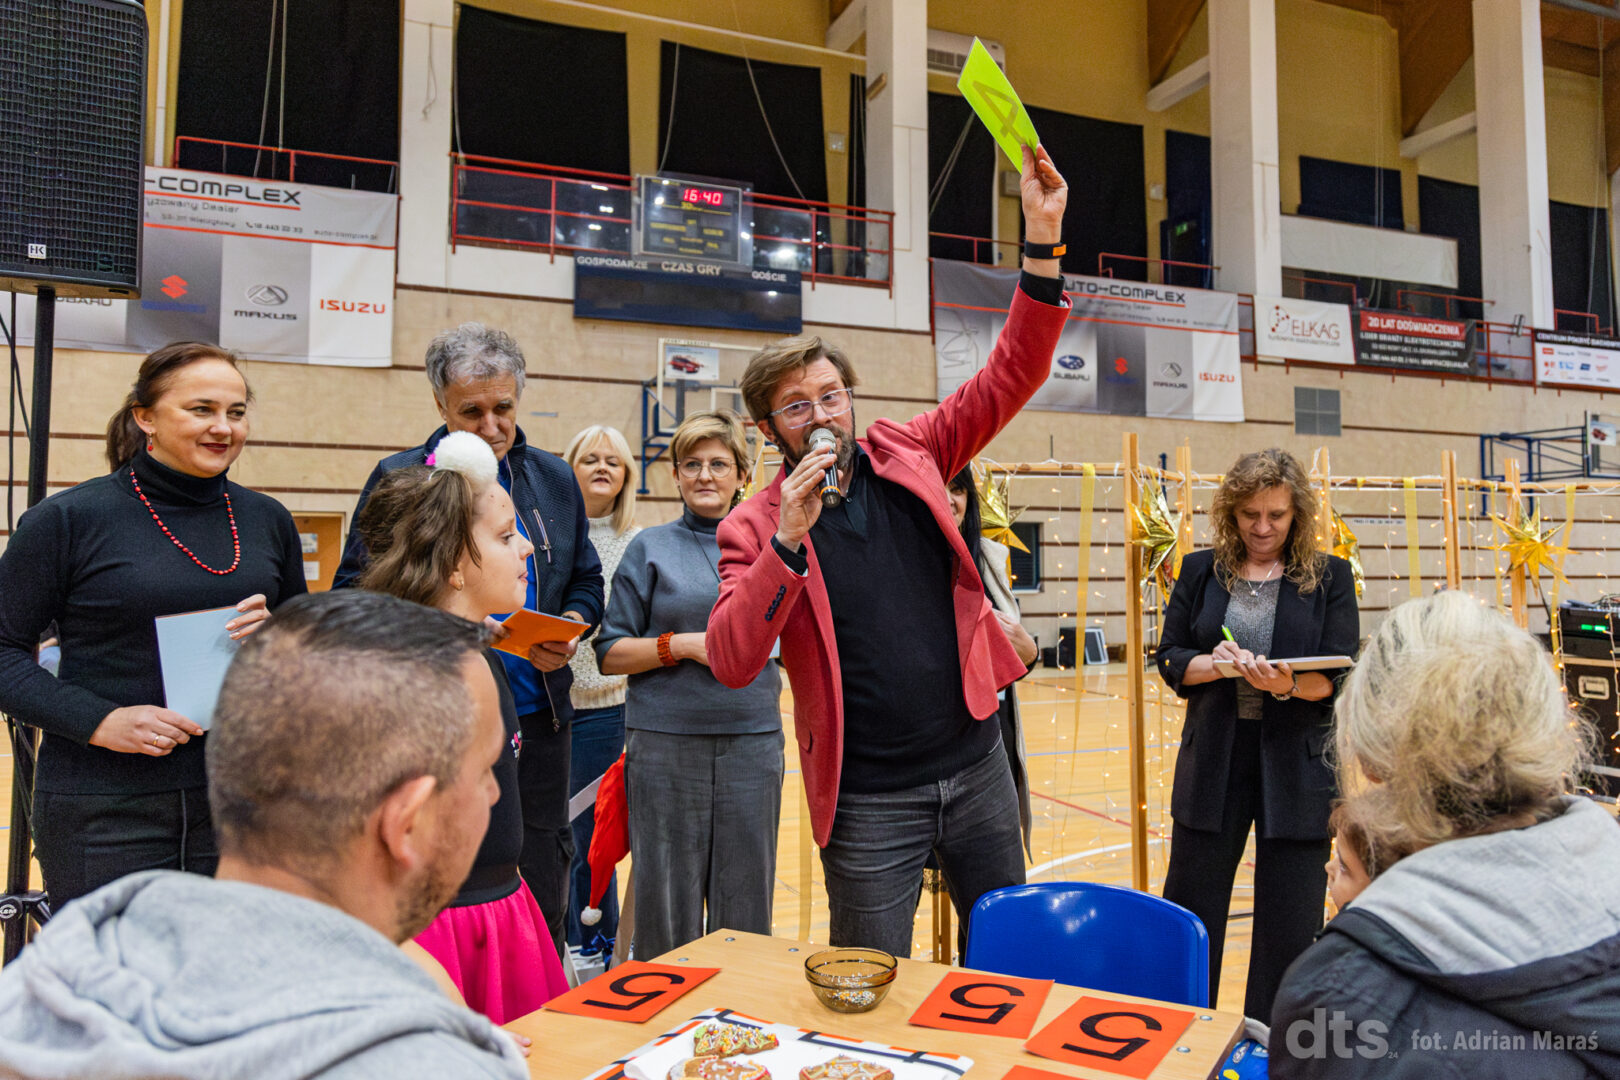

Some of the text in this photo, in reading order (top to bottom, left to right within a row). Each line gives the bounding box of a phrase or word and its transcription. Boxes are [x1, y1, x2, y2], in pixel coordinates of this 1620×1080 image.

[30, 246, 45, 254] HK
[576, 255, 648, 270] GOSPODARZE
[661, 260, 722, 276] CZAS GRY
[752, 270, 787, 282] GOŚCIE
[1065, 279, 1186, 303] UTO-COMPLEX
[319, 298, 386, 314] ISUZU
[234, 308, 298, 321] MAXUS
[1292, 319, 1341, 341] ELKAG
[1368, 316, 1380, 327] 20
[1380, 318, 1396, 330] LAT
[1053, 372, 1090, 382] SUBARU
[1199, 372, 1235, 383] ISUZU
[582, 972, 685, 1011] 5
[940, 983, 1024, 1025] 5
[1061, 1011, 1162, 1062] 5
